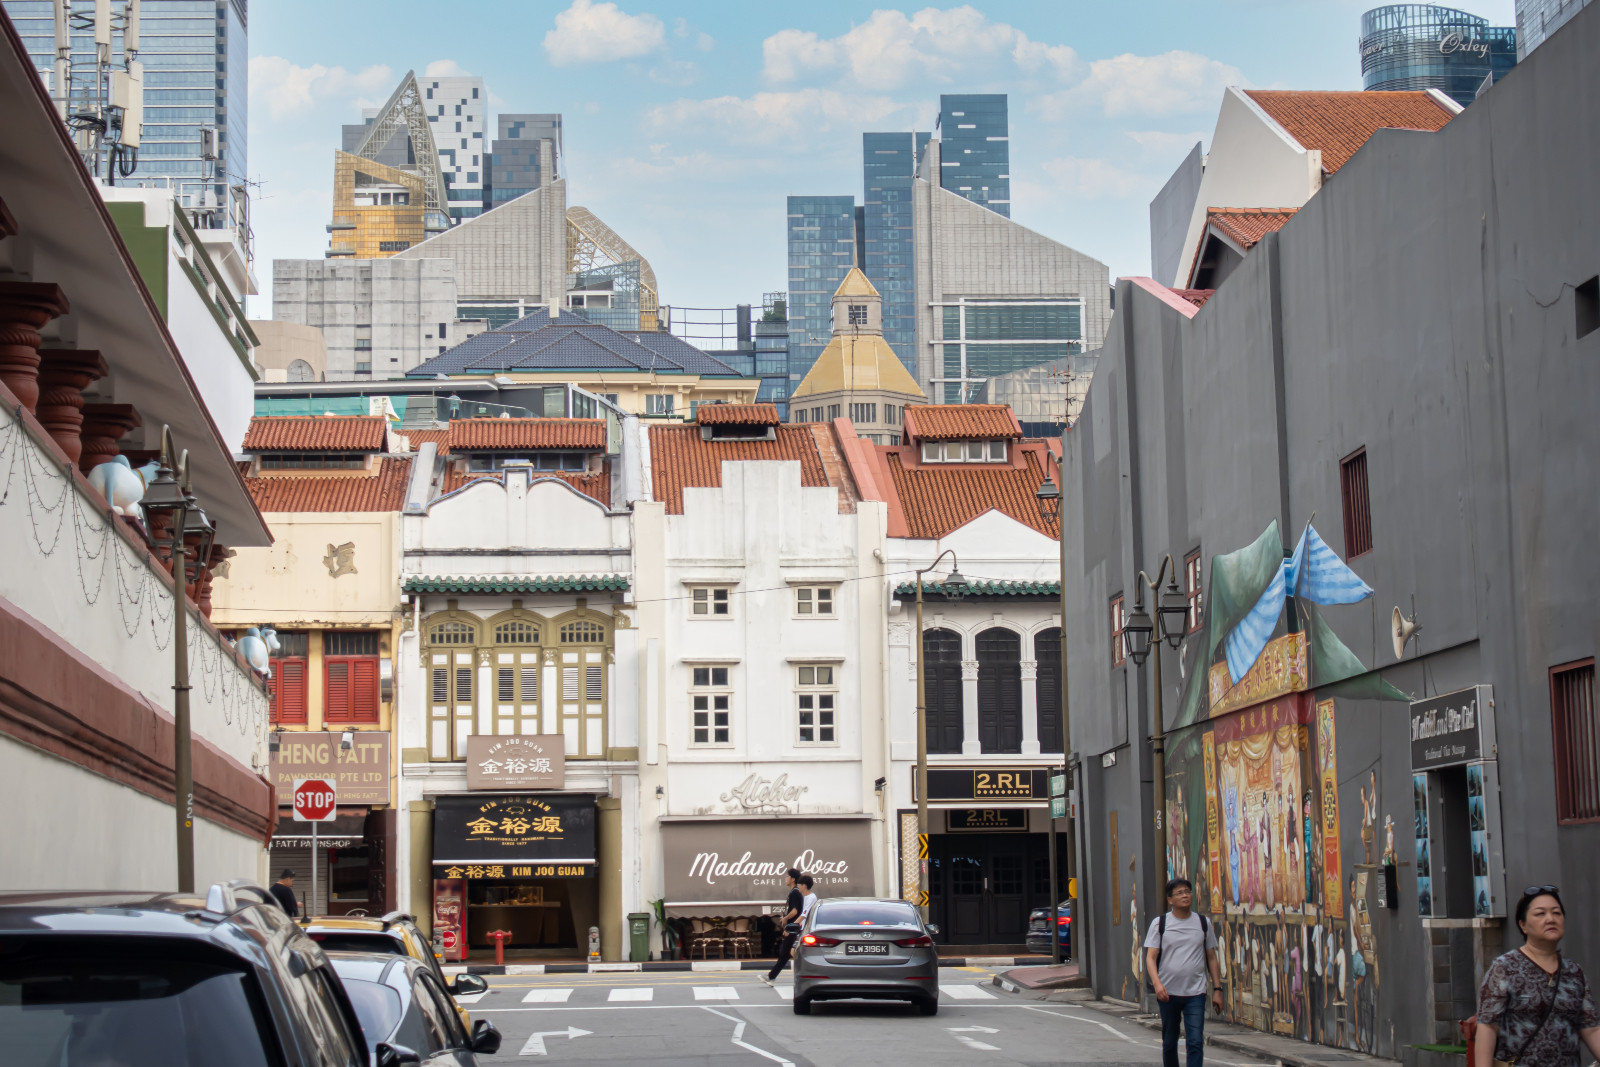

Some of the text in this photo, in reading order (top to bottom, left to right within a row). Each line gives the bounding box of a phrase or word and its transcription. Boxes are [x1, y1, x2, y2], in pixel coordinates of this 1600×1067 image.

[1440, 32, 1489, 58] Oxley
[279, 743, 383, 764] HENG FATT
[488, 738, 543, 755] KIM JOO GUAN
[478, 758, 553, 775] 金裕源
[279, 772, 383, 782] PAWNSHOP PTE LTD
[976, 773, 1030, 789] 2.RL
[296, 791, 334, 809] STOP
[720, 772, 808, 813] Atelier
[479, 801, 497, 813] KIM
[526, 798, 552, 812] GUAN
[966, 809, 1009, 822] 2.RL
[1156, 809, 1162, 830] 23
[466, 816, 564, 835] 金裕源
[275, 840, 298, 848] FATT
[444, 865, 585, 879] 金裕源 KIM JOO GUAN
[688, 848, 849, 885] Madame Ooze
[753, 878, 777, 886] CAFE
[831, 876, 849, 884] BAR
[847, 945, 887, 953] SLW3196K
